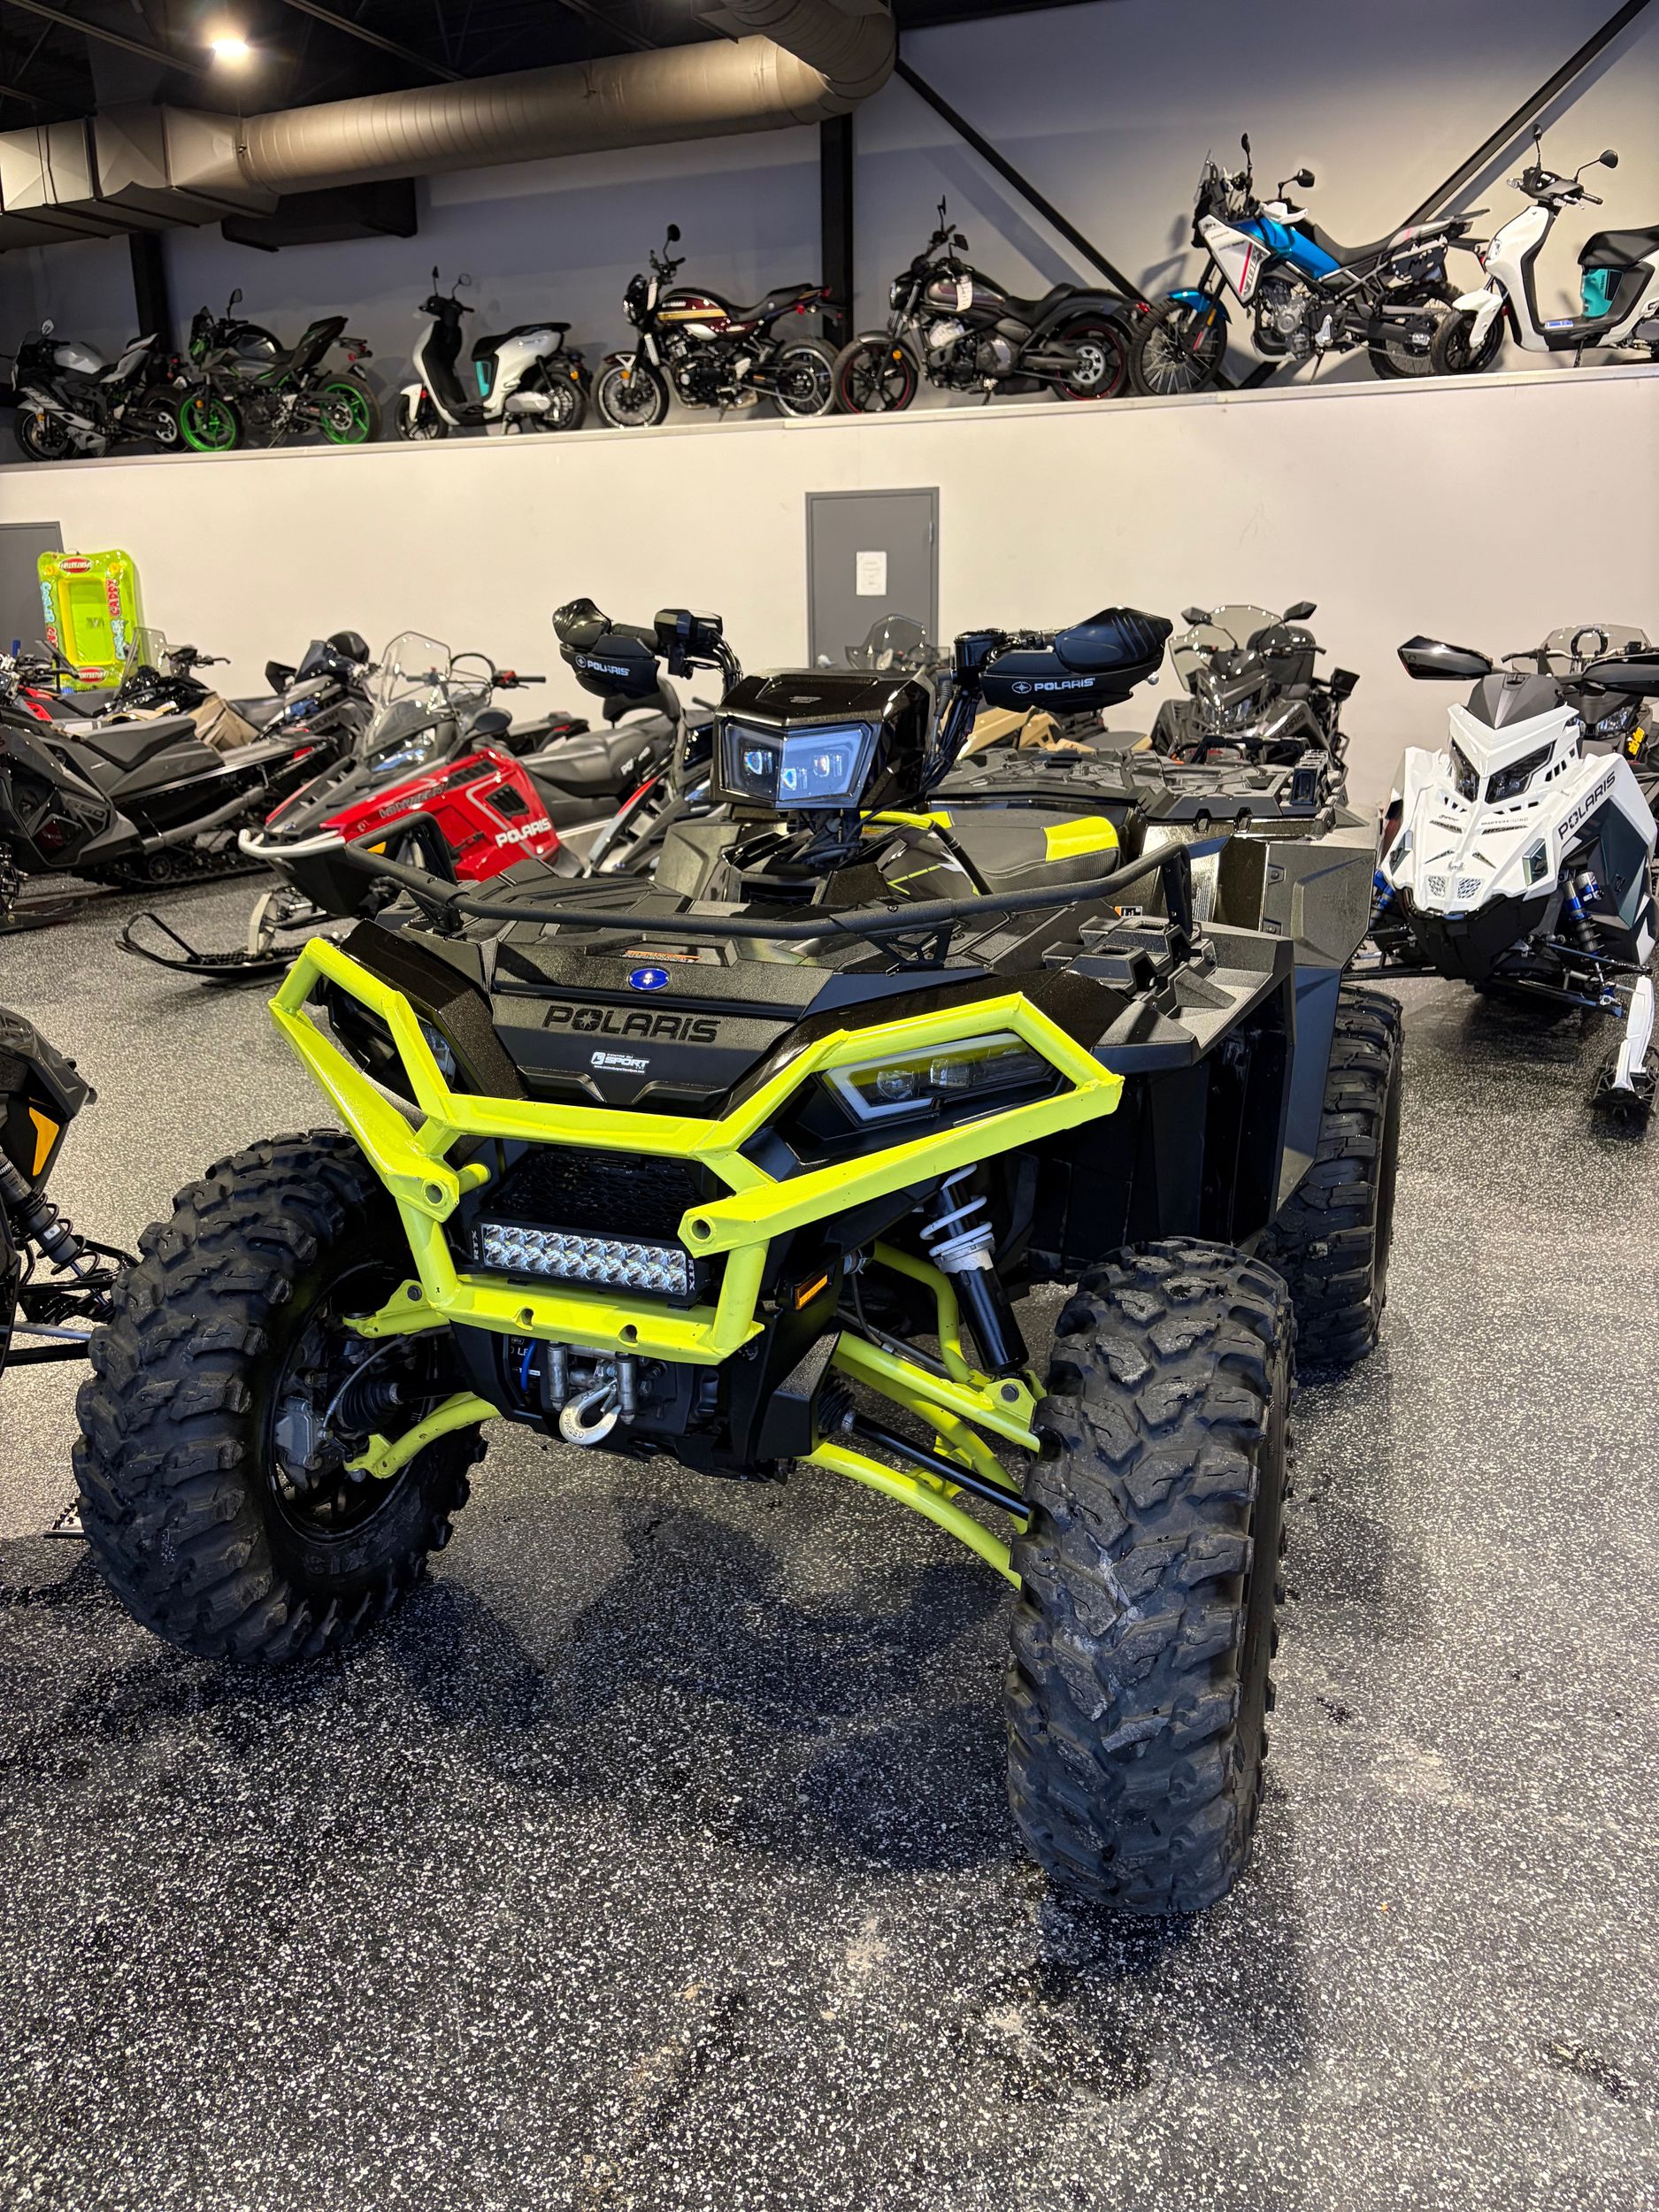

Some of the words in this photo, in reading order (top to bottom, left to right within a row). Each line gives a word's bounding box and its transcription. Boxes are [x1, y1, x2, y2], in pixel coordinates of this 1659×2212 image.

[587, 660, 630, 677] POLARIS
[1033, 678, 1095, 692] POLARIS
[1558, 771, 1616, 841] POLARIS
[495, 818, 552, 848] POLARIS
[541, 1005, 720, 1043] POLARIS
[604, 1056, 649, 1068] SPORT
